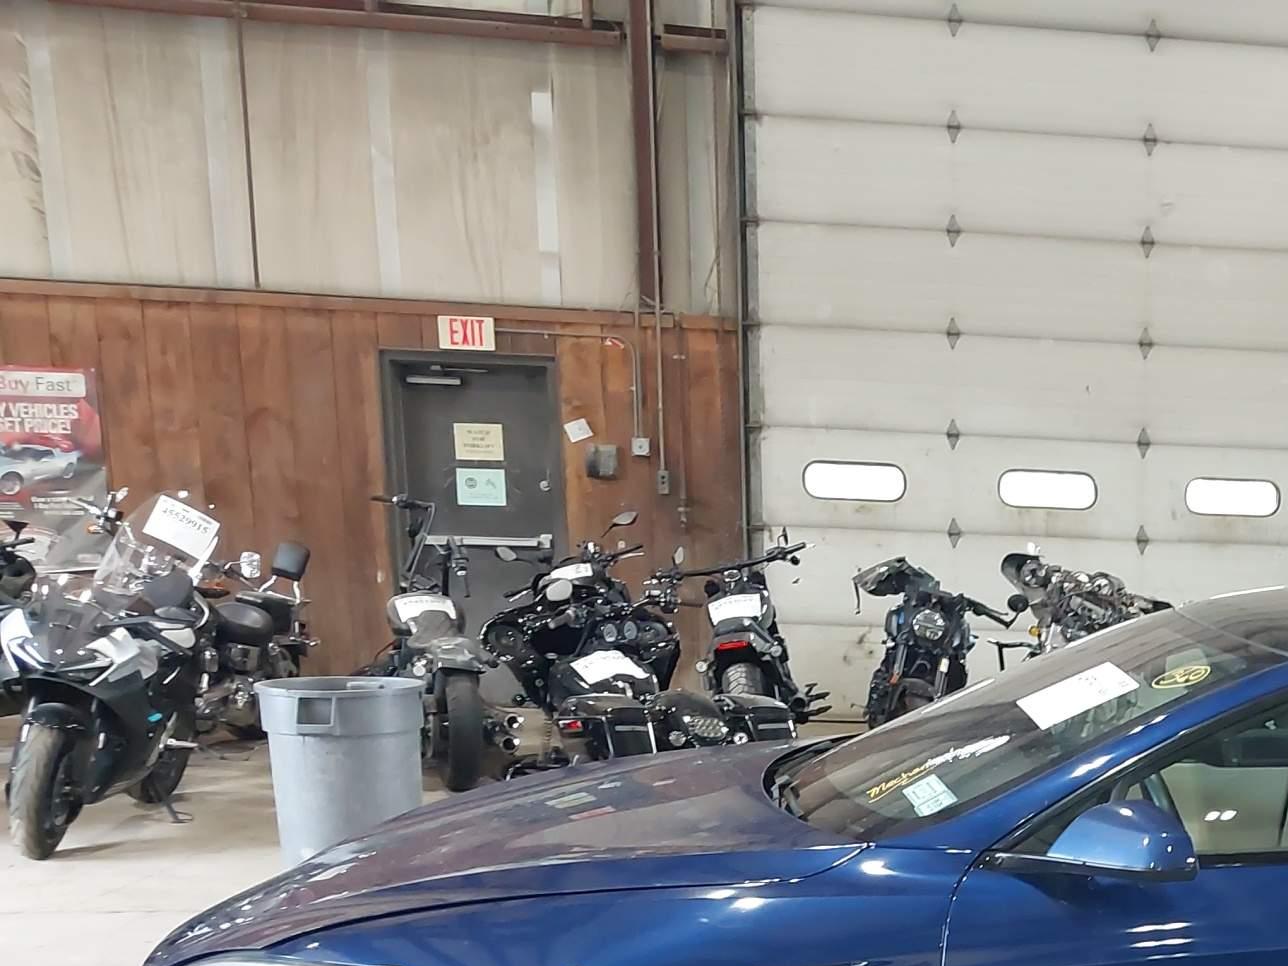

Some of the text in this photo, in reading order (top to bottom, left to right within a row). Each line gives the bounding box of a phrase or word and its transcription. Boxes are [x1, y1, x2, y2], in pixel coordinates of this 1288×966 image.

[449, 318, 484, 346] EXIT
[35, 376, 72, 392] Fast
[8, 402, 79, 419] VEHICLES
[23, 418, 72, 434] PRICE!
